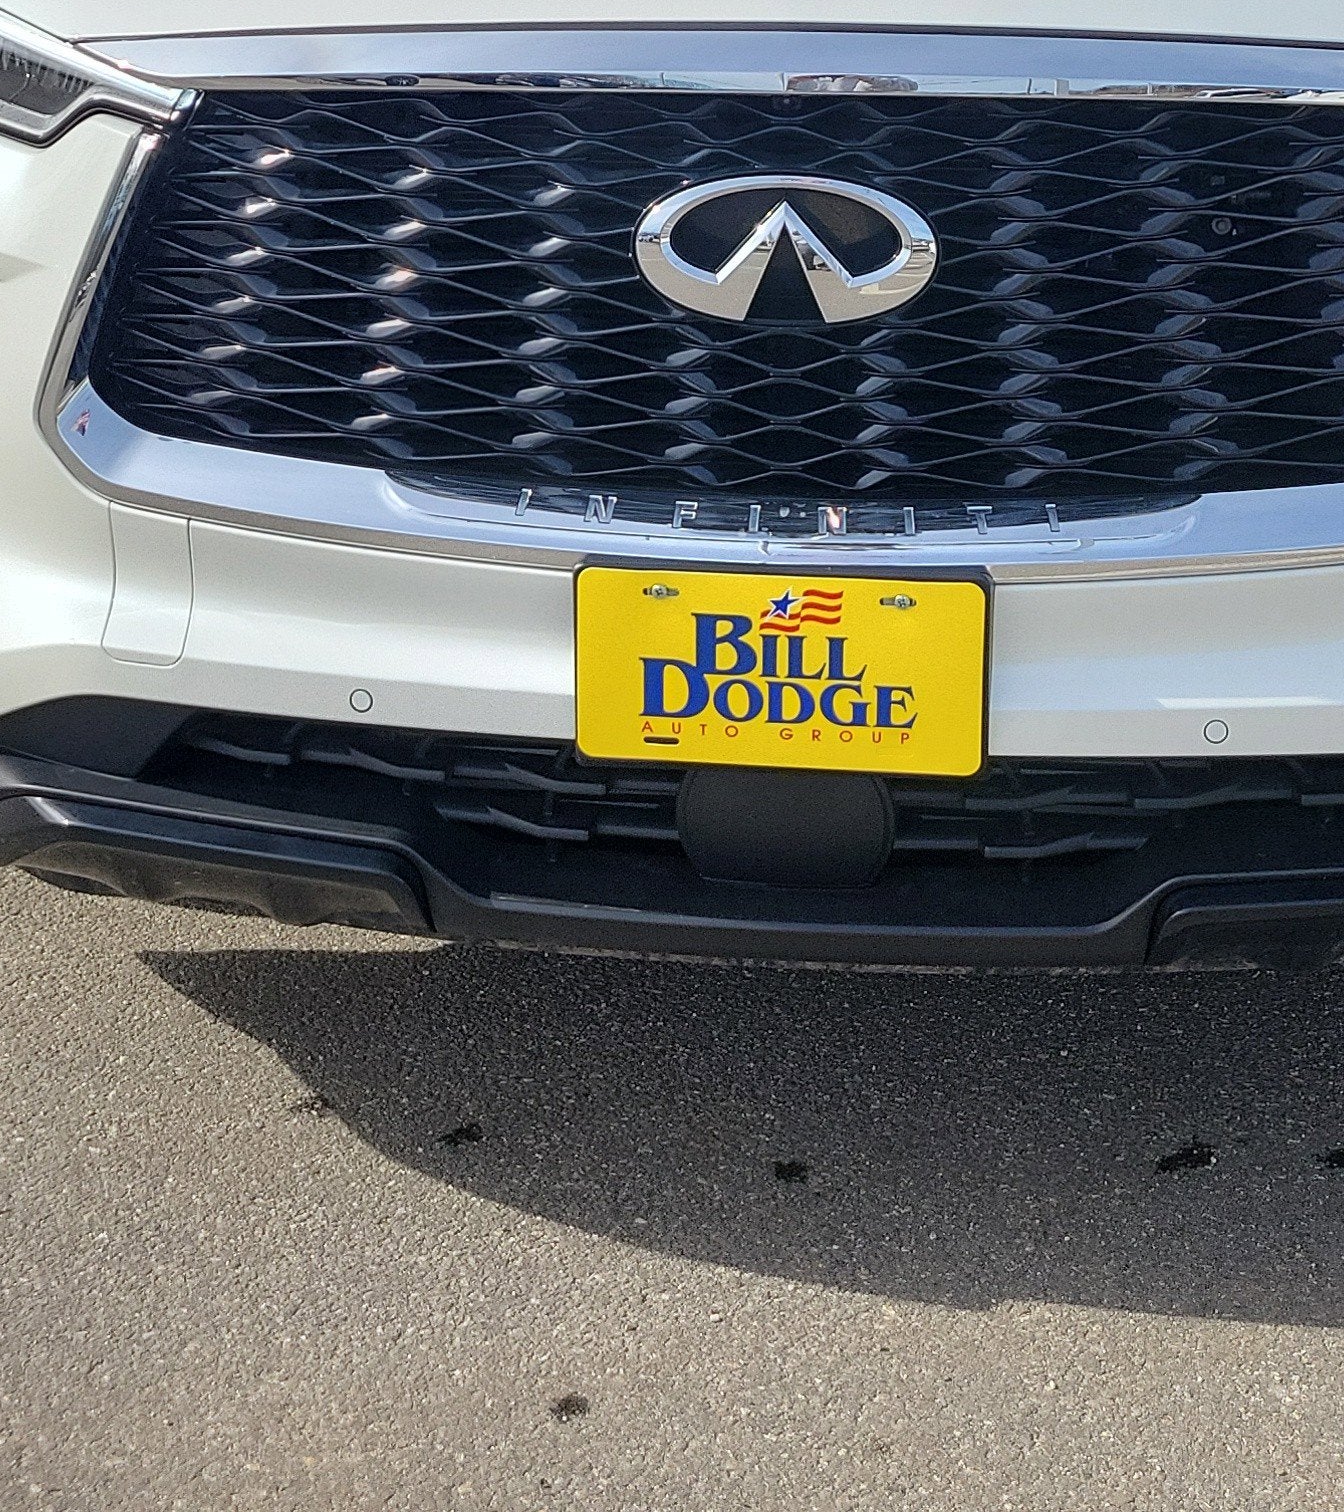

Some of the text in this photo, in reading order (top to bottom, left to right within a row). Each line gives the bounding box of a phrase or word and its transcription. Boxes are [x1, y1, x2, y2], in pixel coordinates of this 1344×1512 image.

[515, 487, 1061, 534] INFINITI
[641, 720, 910, 745] AUTO GROUP
